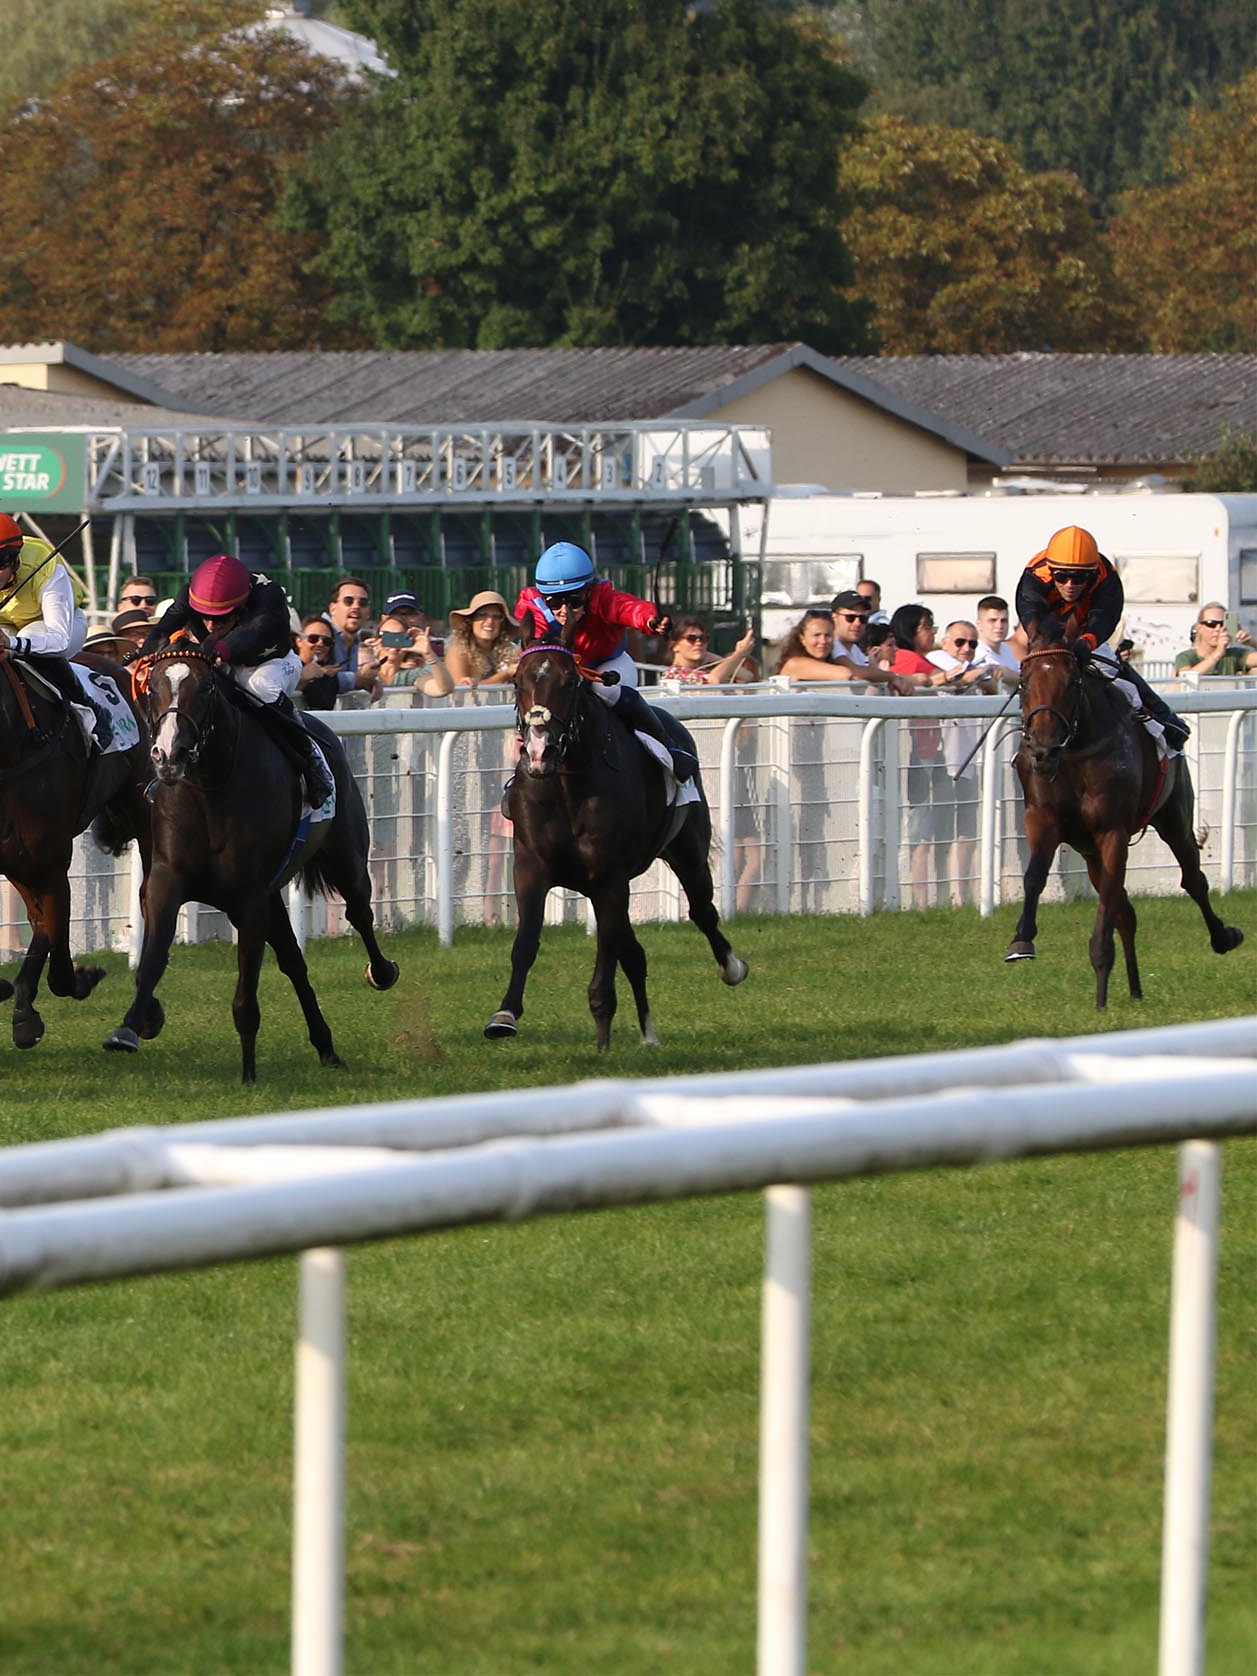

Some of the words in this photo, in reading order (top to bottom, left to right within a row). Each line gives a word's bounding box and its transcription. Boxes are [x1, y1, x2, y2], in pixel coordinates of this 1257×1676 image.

[2, 473, 50, 491] STAR
[146, 468, 158, 490] 12
[198, 468, 208, 489] 11
[406, 466, 413, 486] 7
[506, 463, 513, 484] 5
[606, 464, 613, 483] 3
[88, 672, 121, 706] 5
